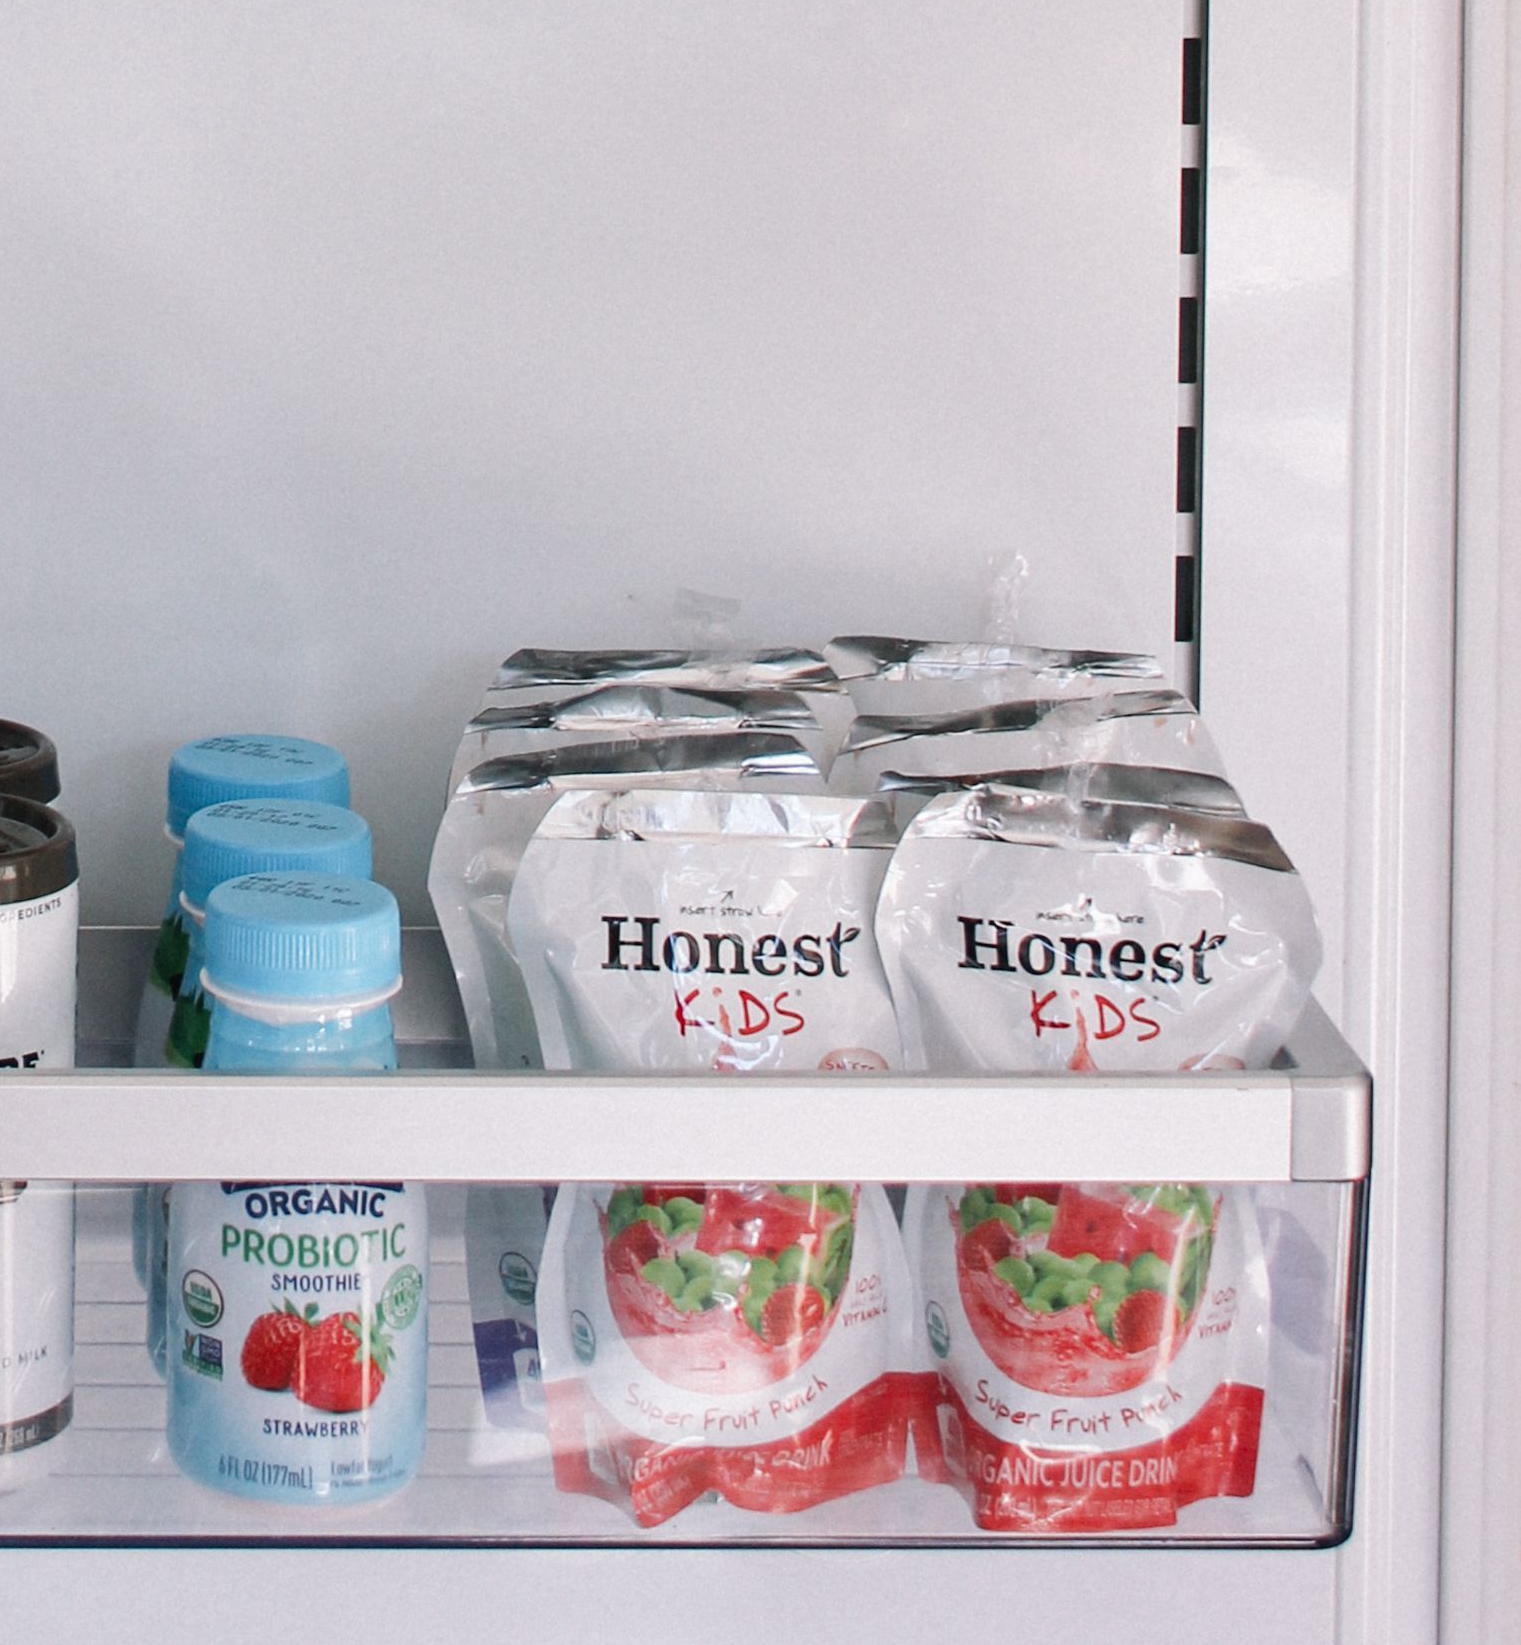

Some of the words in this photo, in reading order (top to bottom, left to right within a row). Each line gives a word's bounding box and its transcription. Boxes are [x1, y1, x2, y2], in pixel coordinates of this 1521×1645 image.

[601, 916, 861, 977] Honest
[957, 915, 1228, 984] Honest
[245, 1189, 385, 1219] ORGANIC
[222, 1223, 406, 1269] PROBIOTIC
[271, 1273, 361, 1292] SMOOTHIE
[625, 1383, 693, 1431] Super
[704, 1408, 760, 1432] Fruit
[769, 1375, 828, 1423] Punch
[975, 1379, 1041, 1426] Super
[1050, 1408, 1112, 1435] Fruit
[1061, 1457, 1123, 1490] JUICE
